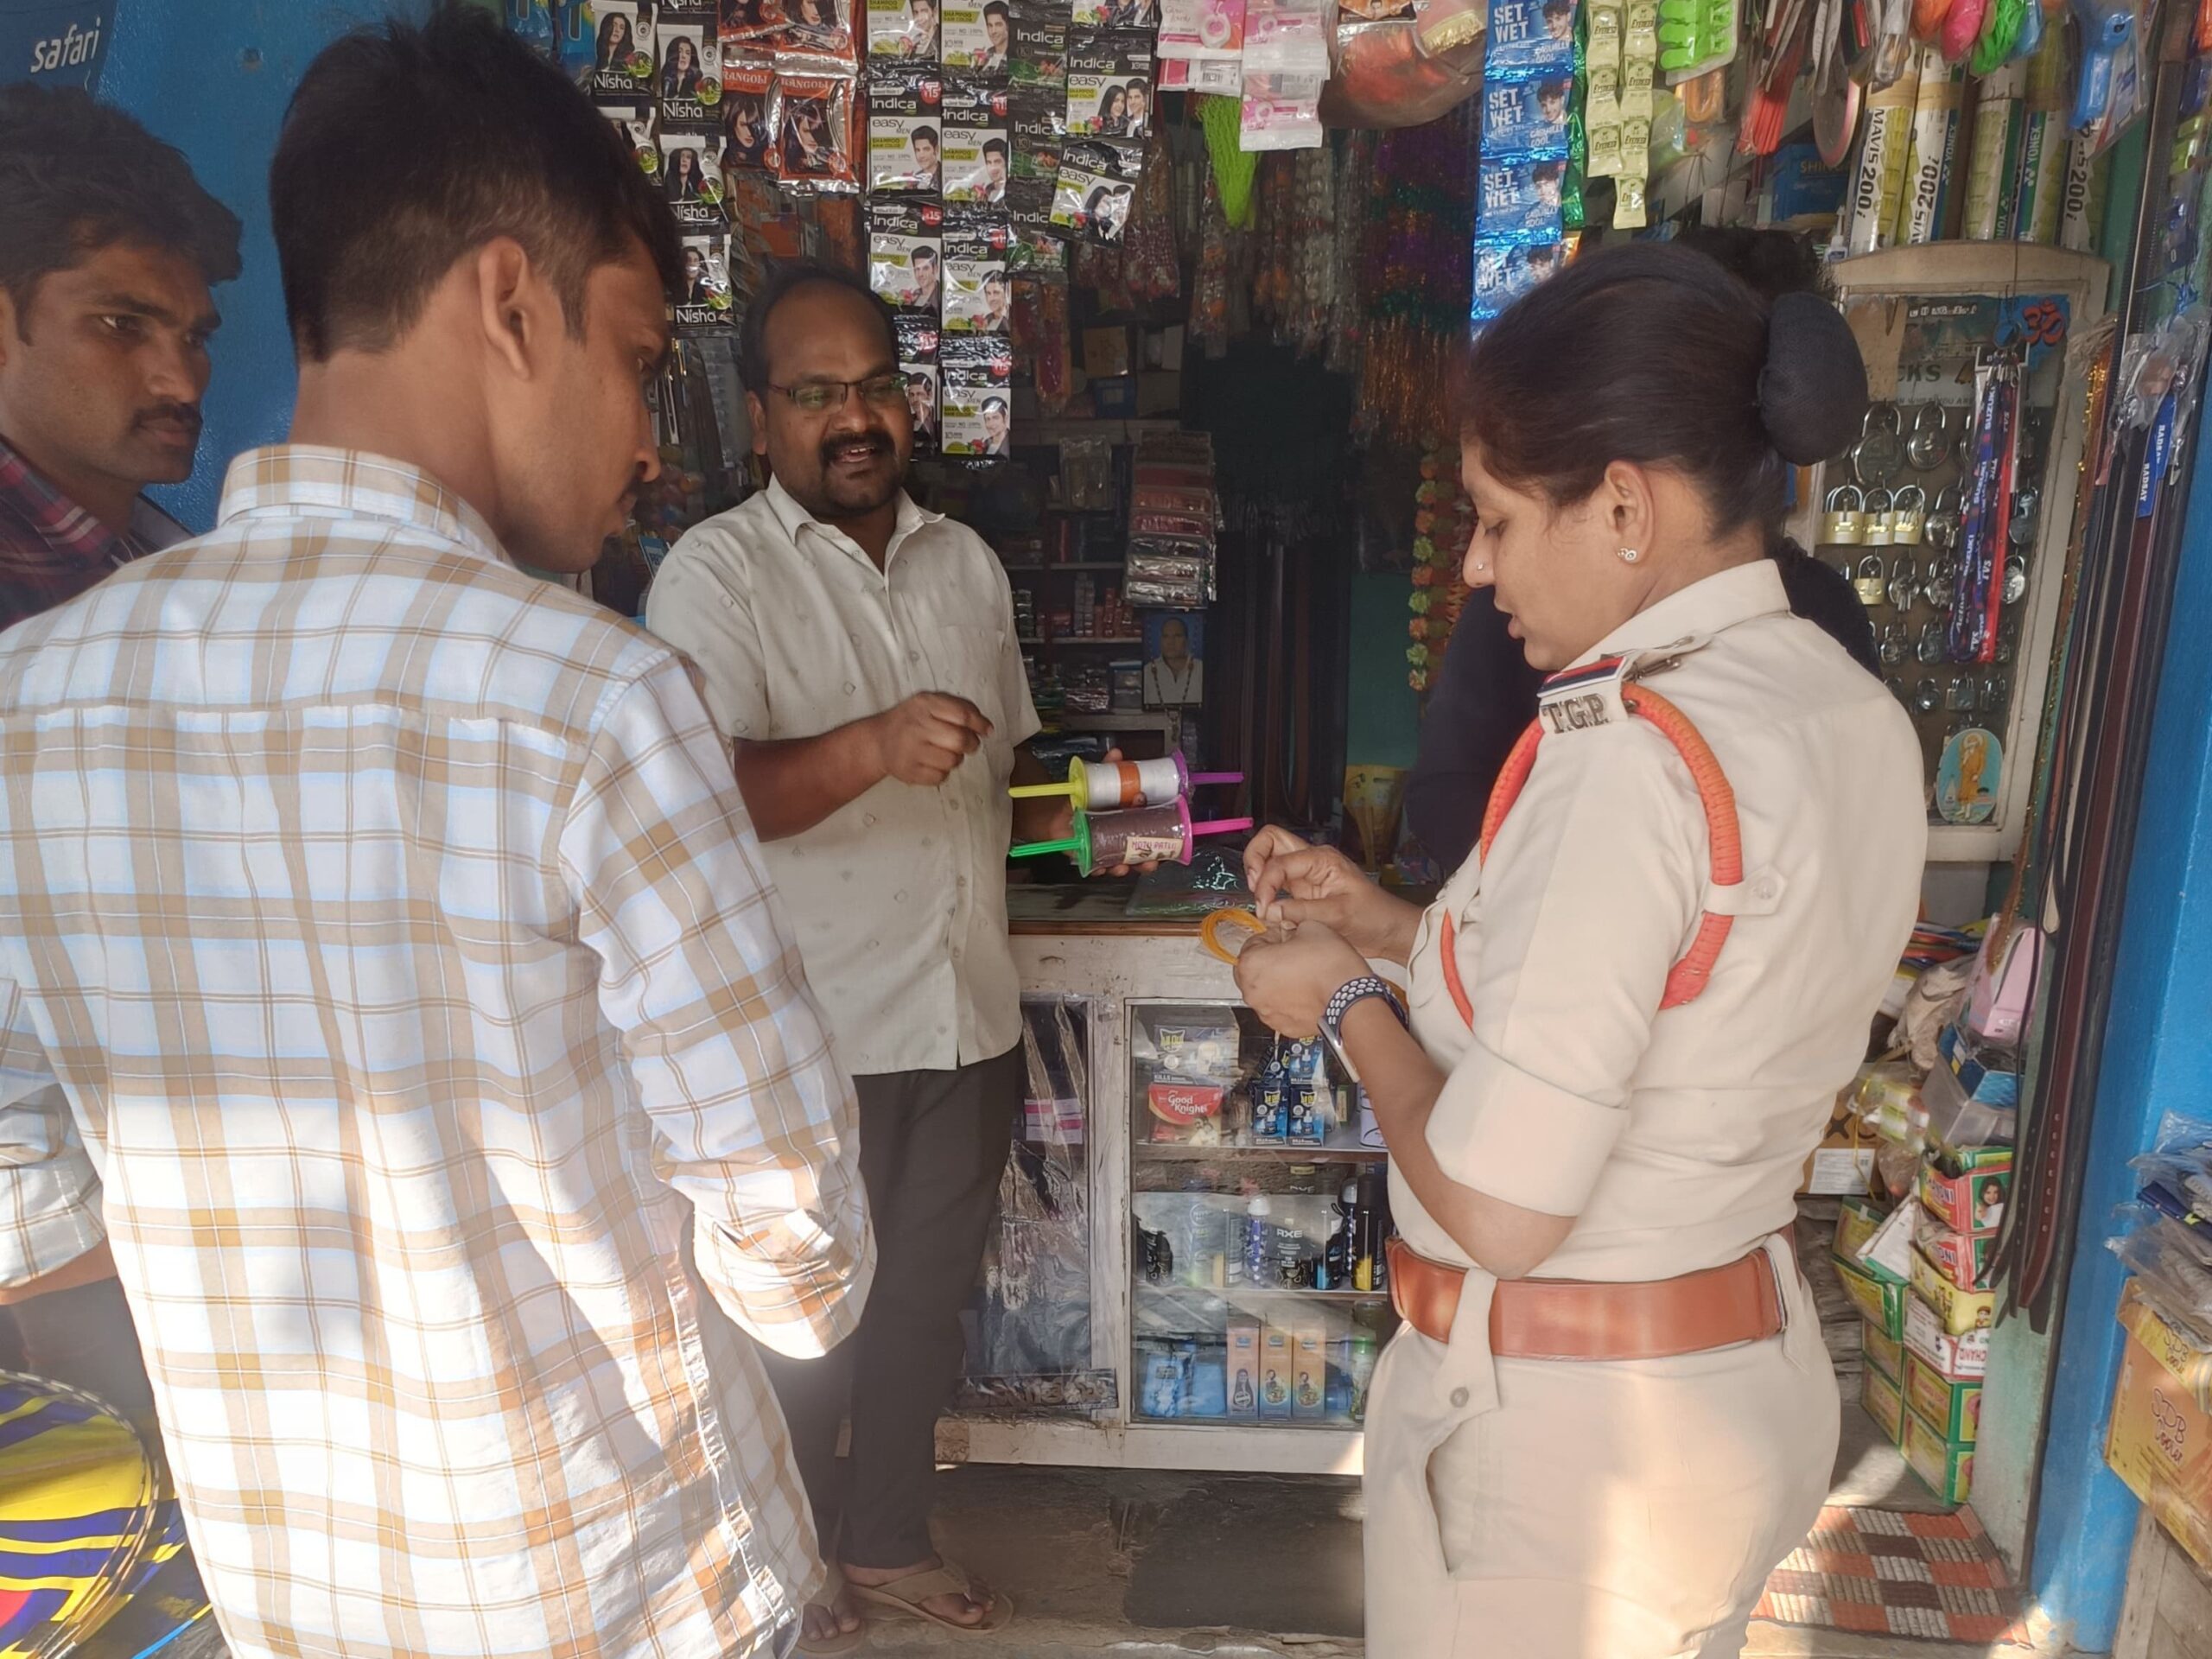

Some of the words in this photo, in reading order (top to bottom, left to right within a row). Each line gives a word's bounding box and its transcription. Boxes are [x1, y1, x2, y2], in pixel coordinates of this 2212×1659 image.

[1494, 3, 1524, 25] SET
[1017, 29, 1064, 44] Indica
[1495, 21, 1529, 43] WET
[30, 16, 101, 73] safari
[1070, 56, 1116, 69] Indica
[594, 73, 633, 90] Nisha
[1069, 76, 1107, 87] easy
[872, 98, 917, 110] Indica
[1489, 88, 1519, 110] SET
[663, 101, 702, 118] Nisha
[944, 109, 988, 122] Indica
[1490, 105, 1523, 128] WET
[872, 118, 905, 129] easy
[944, 130, 976, 141] easy
[1867, 108, 1885, 165] MAVIS
[1945, 124, 1957, 161] YONEX
[2026, 125, 2041, 164] YONEX
[1063, 148, 1109, 170] Indica
[1059, 168, 1096, 187] easy
[1917, 156, 1940, 209] 200i
[1856, 166, 1876, 219] 200i
[2065, 169, 2087, 221] 200i
[874, 215, 918, 230] Indica
[1014, 211, 1049, 223] Indic
[873, 235, 906, 247] easy
[944, 243, 988, 254] Indica
[676, 308, 717, 324] Nisha
[1985, 386, 1996, 430] SUZUKI
[1974, 461, 1986, 504] SUZUKI
[1542, 694, 1611, 734] TGP
[1168, 1093, 1193, 1106] Good
[1276, 1228, 1303, 1238] AXE
